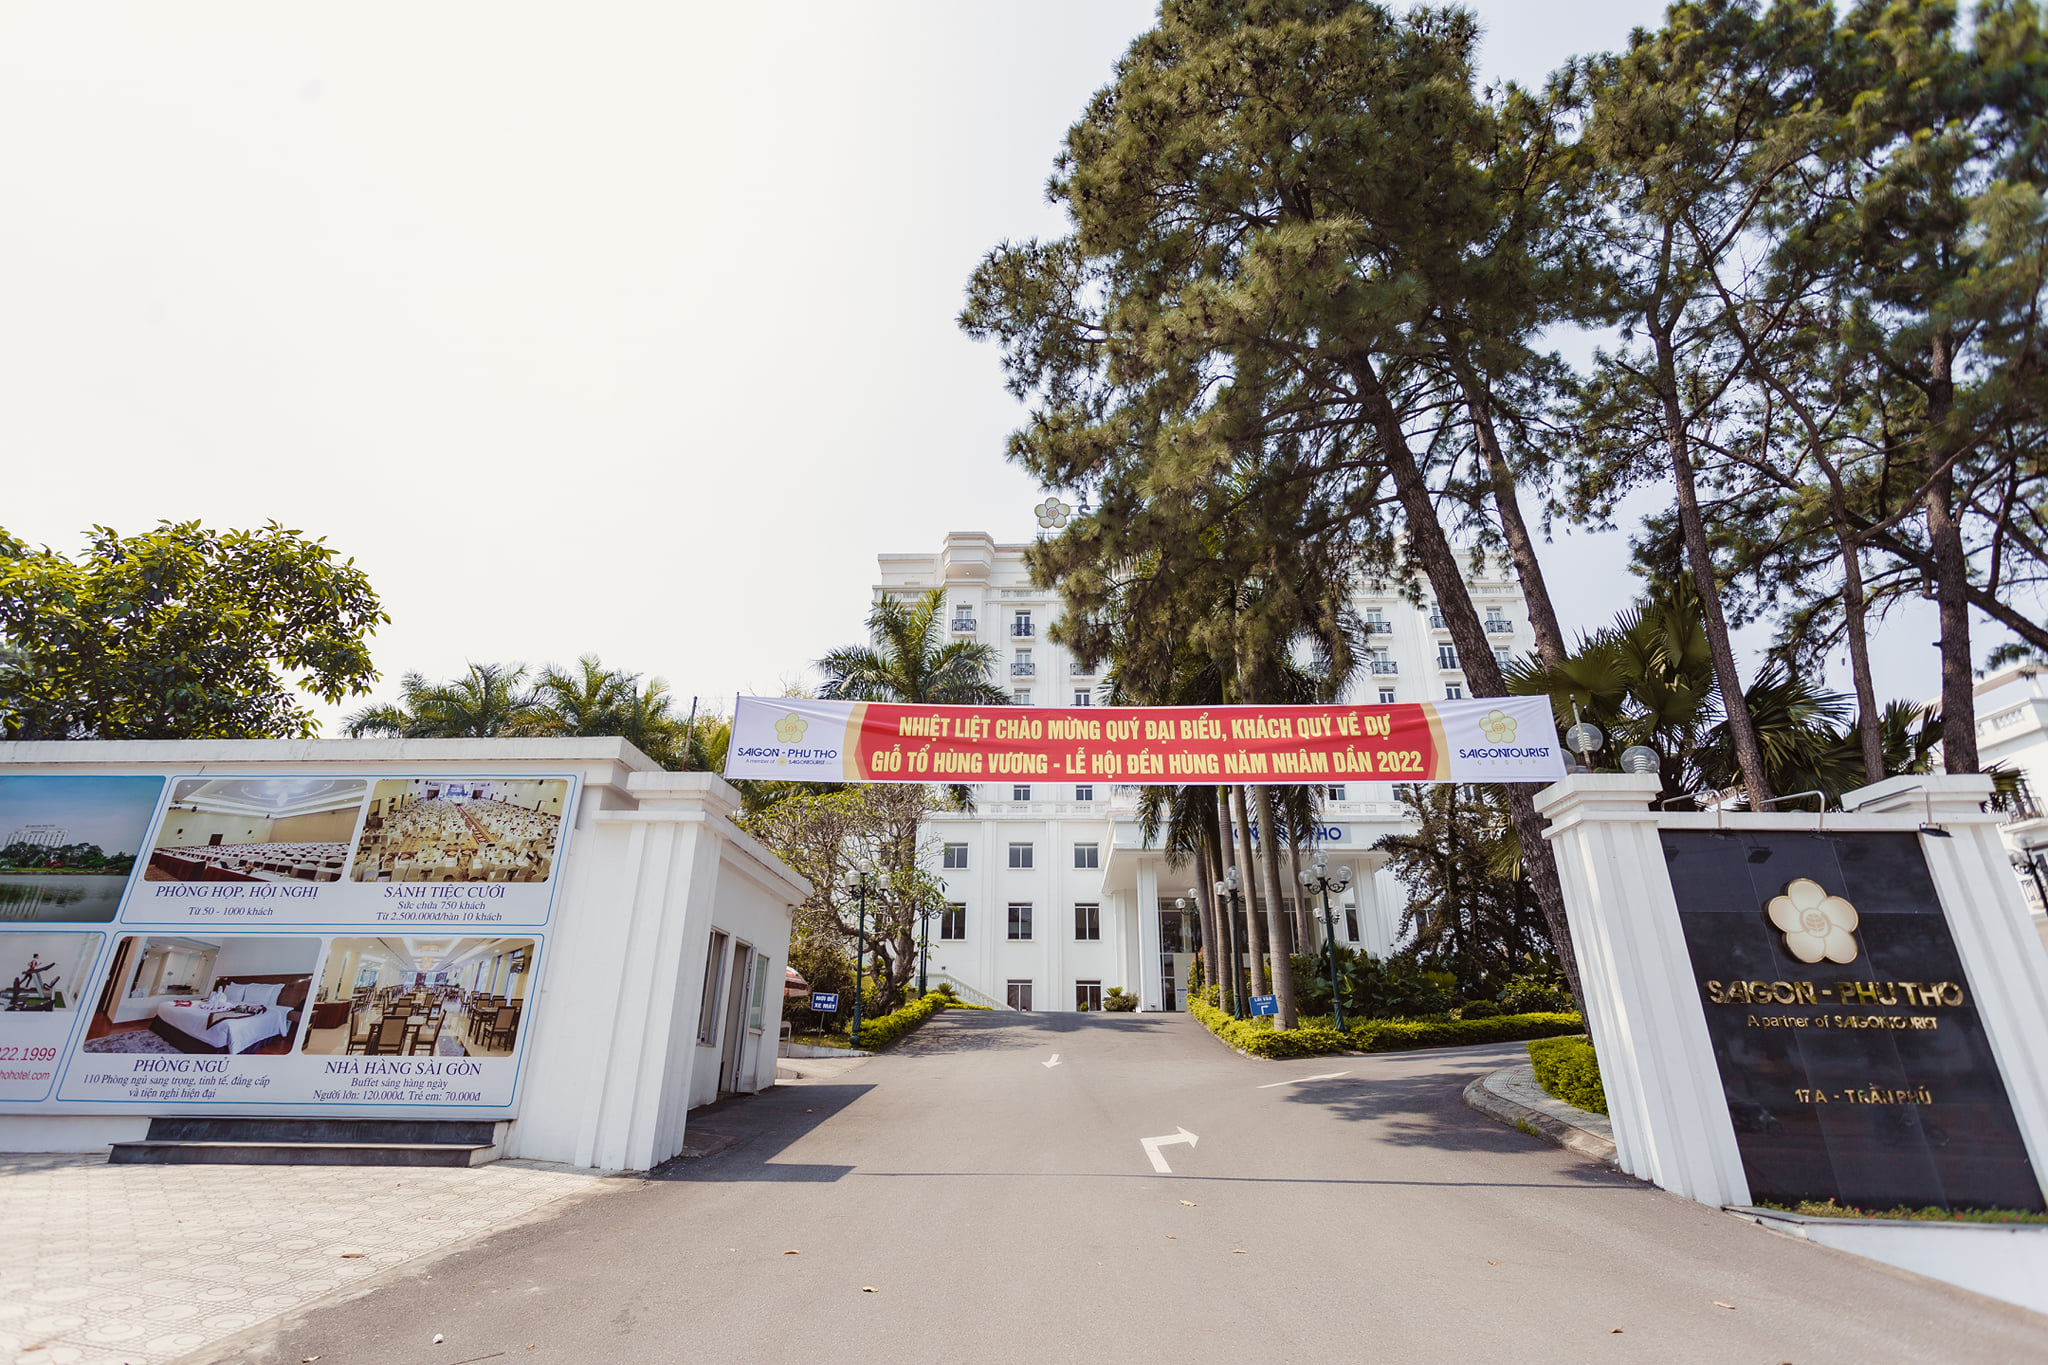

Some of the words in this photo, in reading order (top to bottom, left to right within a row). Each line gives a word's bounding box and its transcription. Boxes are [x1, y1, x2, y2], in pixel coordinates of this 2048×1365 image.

[899, 714, 950, 742] NHIỆT
[954, 715, 990, 742] LIỆT
[996, 716, 1042, 740] CHÀO
[1048, 716, 1100, 740] MỪNG
[1106, 716, 1140, 742] QUÝ
[1145, 720, 1176, 744] ĐẠI
[1180, 712, 1228, 742] BIỂU,
[1232, 715, 1292, 739] KHÁCH
[1298, 714, 1332, 739] QUÝ
[1336, 711, 1362, 737] VỀ
[1365, 714, 1391, 740] DỰ
[738, 747, 780, 758] SAIGON
[788, 748, 812, 758] PHU
[813, 750, 838, 759] THO
[1459, 748, 1550, 758] SAIGONTOURIST
[871, 744, 902, 772] GIỖ
[906, 744, 930, 773] TỔ
[933, 751, 982, 774] HÙNG
[988, 752, 1048, 774] VƯƠNG
[1066, 747, 1087, 774] LỄ
[1092, 751, 1122, 778] HỘI
[1126, 748, 1164, 774] ĐỀN
[1168, 750, 1220, 774] HÙNG
[1224, 749, 1268, 774] NĂM
[1272, 748, 1328, 774] NHÂM
[1332, 744, 1374, 773] DẦN
[1376, 750, 1424, 772] 2022
[156, 883, 208, 898] PHÒNG
[212, 886, 244, 900] HỌP,
[249, 884, 278, 900] HỘI
[280, 886, 319, 900] NGHỊ
[431, 884, 464, 900] TIỆC
[467, 884, 505, 898] CƯỚI
[202, 907, 214, 916] 50
[223, 907, 245, 916] 1000
[247, 906, 273, 916] khách
[441, 901, 458, 910] 750
[459, 901, 486, 910] khách
[463, 912, 474, 920] 10
[476, 912, 502, 920] khách
[1706, 980, 1817, 1004] SAIGON
[1835, 981, 1898, 1005] PHU
[1898, 982, 1965, 1006] THO
[1748, 1014, 1760, 1027] A
[1762, 1014, 1809, 1030] partner
[1815, 1014, 1829, 1028] of
[1834, 1015, 1938, 1030] SAIGONTOURIST
[0, 1046, 56, 1061] 22.1999
[133, 1056, 190, 1072] PHÒNG
[192, 1056, 230, 1072] NGỦ
[324, 1058, 360, 1074] NHÀ
[364, 1058, 412, 1075] HÀNG
[414, 1059, 442, 1075] SÀI
[446, 1060, 482, 1076] GÒN
[84, 1074, 100, 1084] 110
[101, 1074, 128, 1086] Phòng
[149, 1078, 170, 1087] sang
[351, 1078, 378, 1086] Buffet
[381, 1078, 400, 1089] sáng
[403, 1078, 424, 1090] hàng
[426, 1079, 448, 1090] ngày
[129, 1088, 139, 1097] và
[1844, 1082, 1894, 1104] TRẦN
[1897, 1086, 1932, 1104] PHÚ
